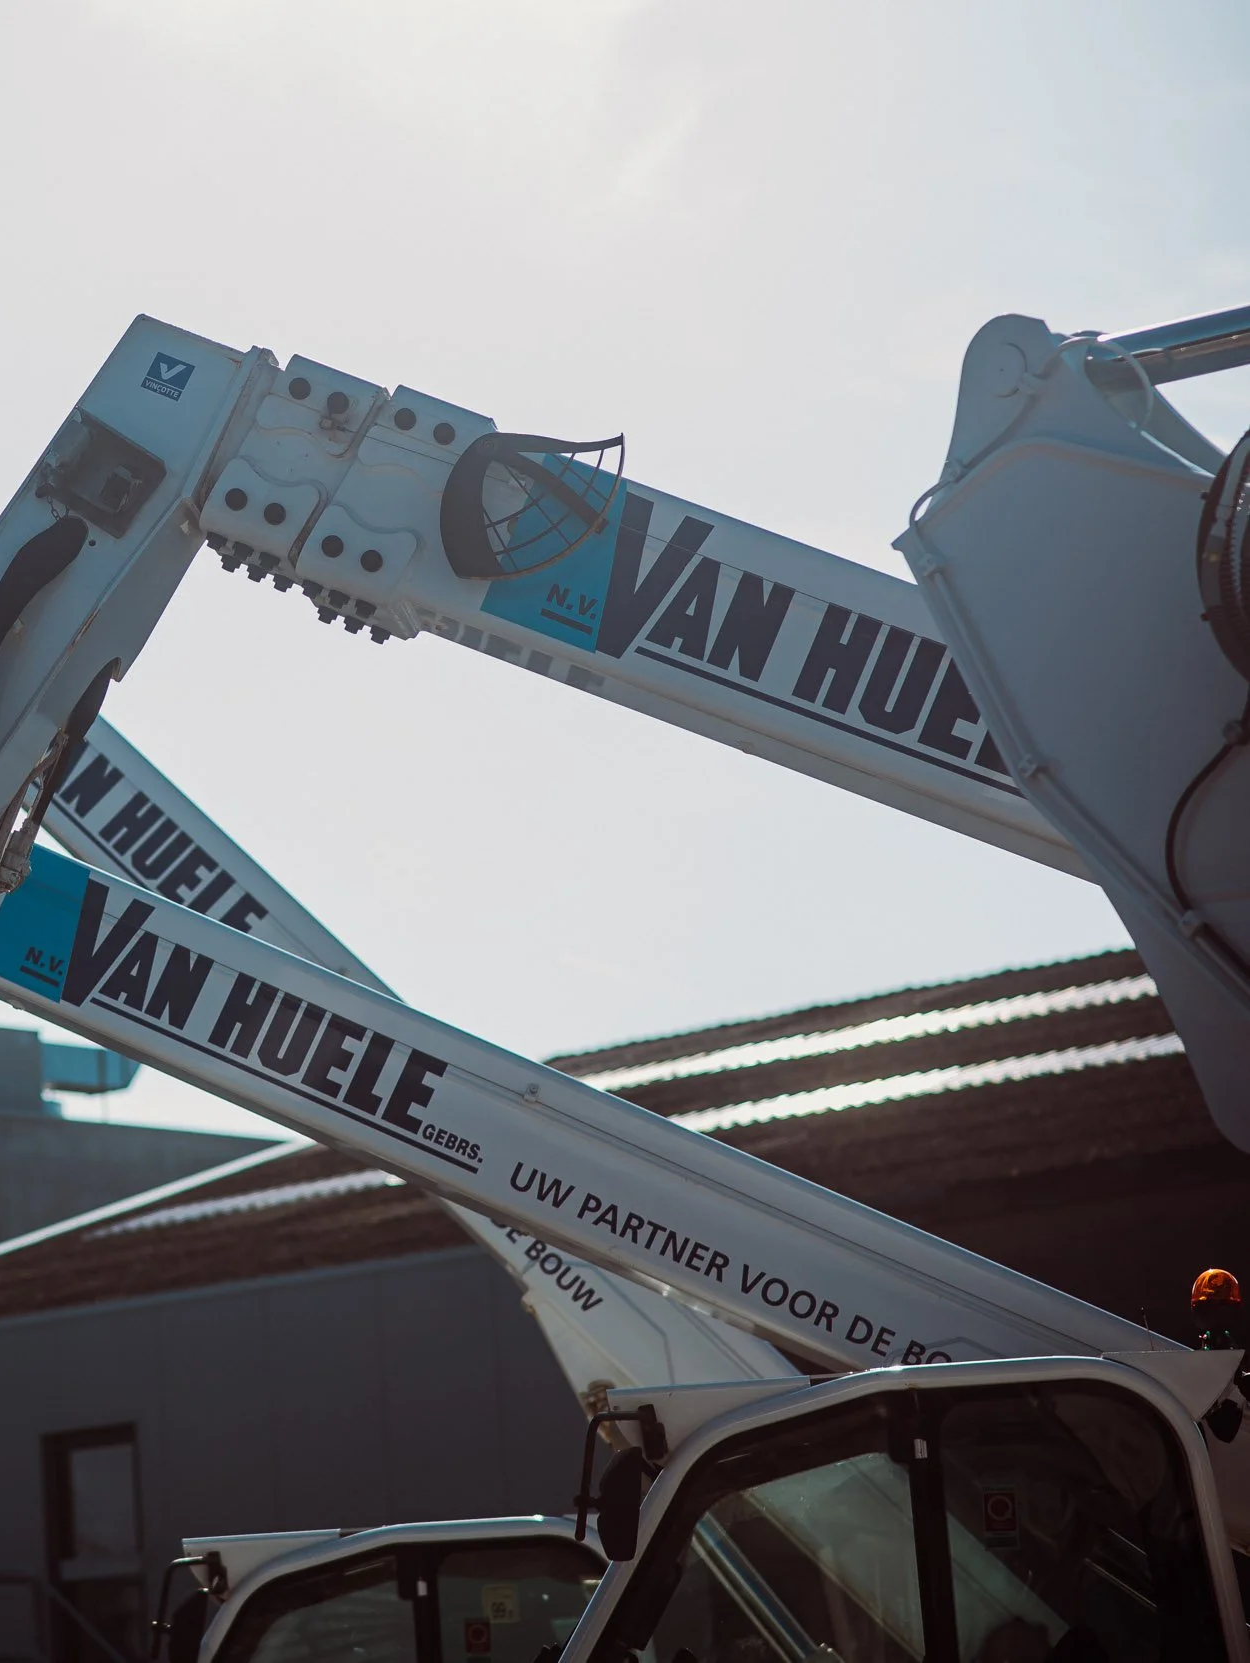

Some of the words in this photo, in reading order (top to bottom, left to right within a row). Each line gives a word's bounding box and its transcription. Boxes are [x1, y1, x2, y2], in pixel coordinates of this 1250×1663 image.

[547, 583, 597, 621] N.V.
[595, 491, 796, 682] VAN
[791, 602, 1016, 776] HUE
[25, 945, 65, 977] N.V.
[61, 878, 216, 1031] VAN
[208, 971, 450, 1135] HUELE
[422, 1123, 484, 1163] GEBRS.
[509, 1161, 576, 1209] UW
[576, 1192, 730, 1284] PARTNER
[740, 1263, 840, 1333] VOOR
[844, 1314, 897, 1358] DE
[523, 1239, 604, 1312] BOUW
